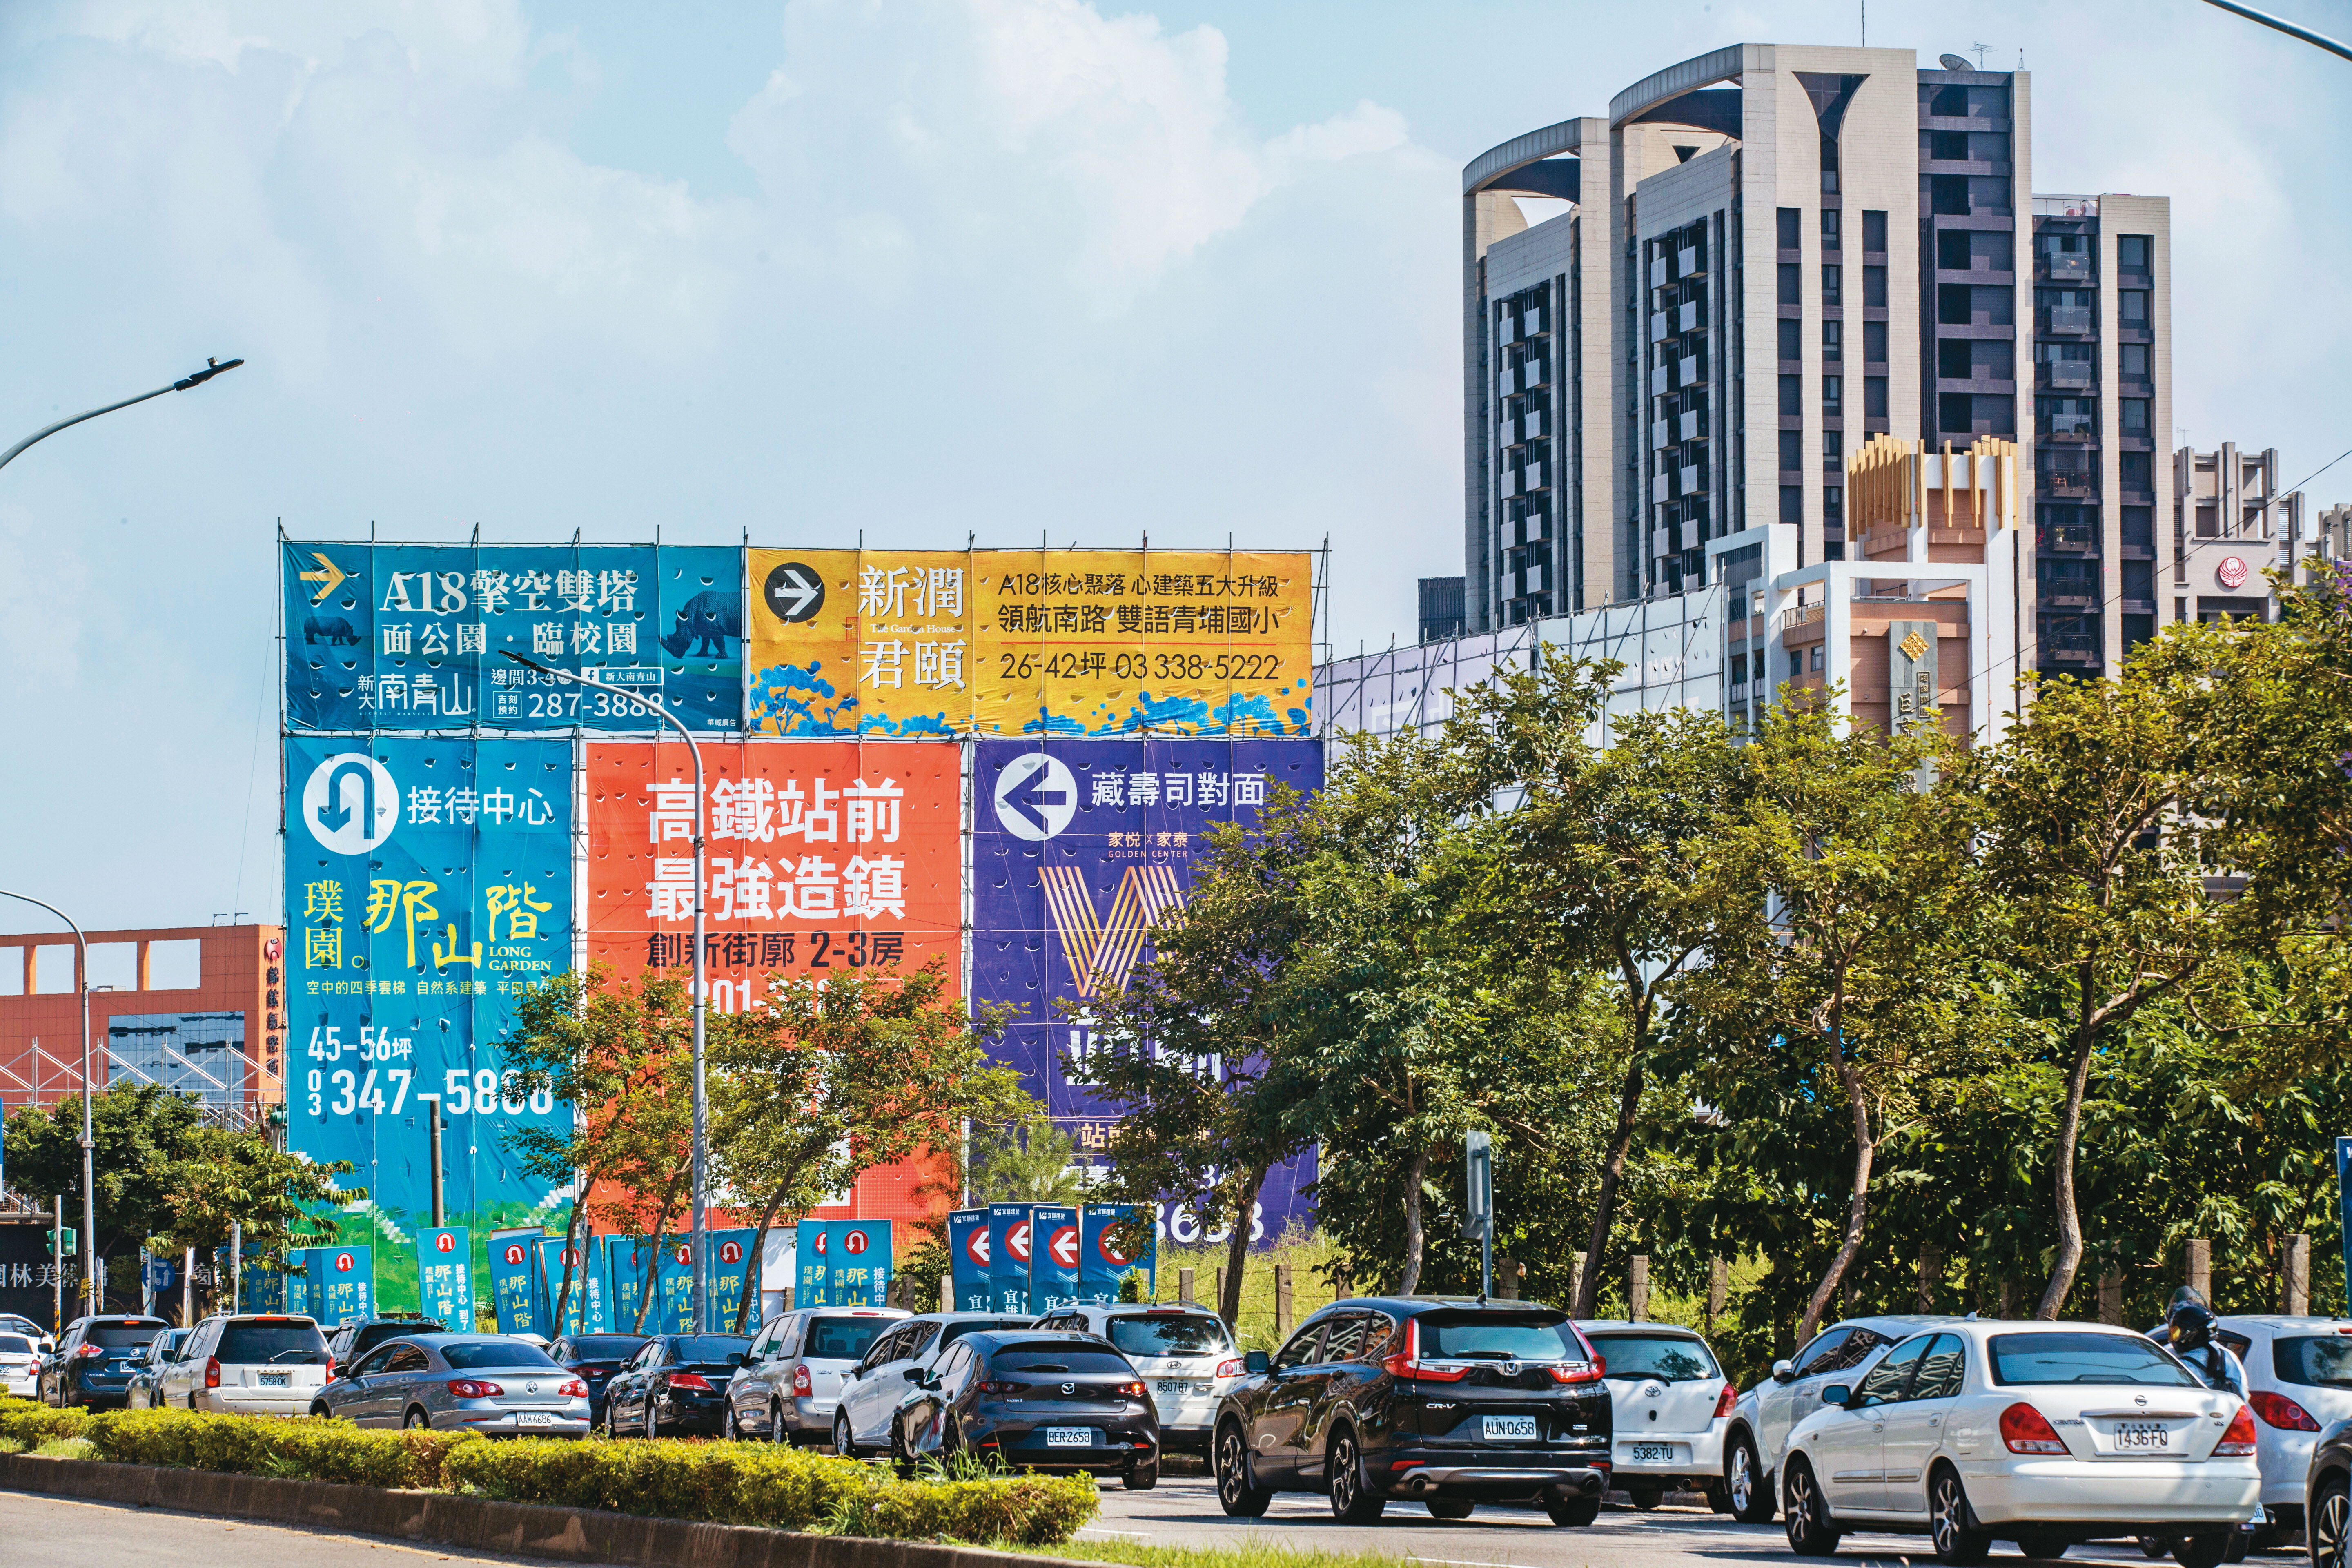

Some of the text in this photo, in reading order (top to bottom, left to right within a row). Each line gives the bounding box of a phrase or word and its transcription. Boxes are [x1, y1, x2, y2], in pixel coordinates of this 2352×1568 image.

[379, 569, 638, 614] A18擎空雙塔
[858, 564, 964, 618] 新潤
[998, 573, 1278, 597] A18核心聚落 心建築五大升級
[870, 624, 956, 633] The Garden House
[998, 604, 1279, 634] 領航南路 雙語青埔國小
[606, 672, 655, 682] 新大南青山
[859, 639, 967, 690] 君頤
[1001, 652, 1279, 679] 26-42坪 03 338-5222
[358, 675, 375, 709] 新大
[498, 706, 517, 715] 預約
[407, 786, 554, 825] 接待中心
[1092, 772, 1265, 806] 藏壽司對面
[646, 777, 904, 844] 高鐵站前
[1157, 832, 1188, 847] 家泰
[646, 855, 906, 921] 最強造鎮
[489, 947, 532, 957] LONG
[489, 960, 552, 971] GARDEN
[647, 930, 904, 967] 創新街廓 2-3房
[307, 980, 405, 995] 空中的四季雲梯
[417, 980, 486, 995] 自然系建築
[308, 1027, 412, 1061] 45-56坪
[456, 1263, 469, 1330] 接待中心 到了
[588, 1277, 603, 1322] 接待中心
[749, 1275, 760, 1323] 待中心
